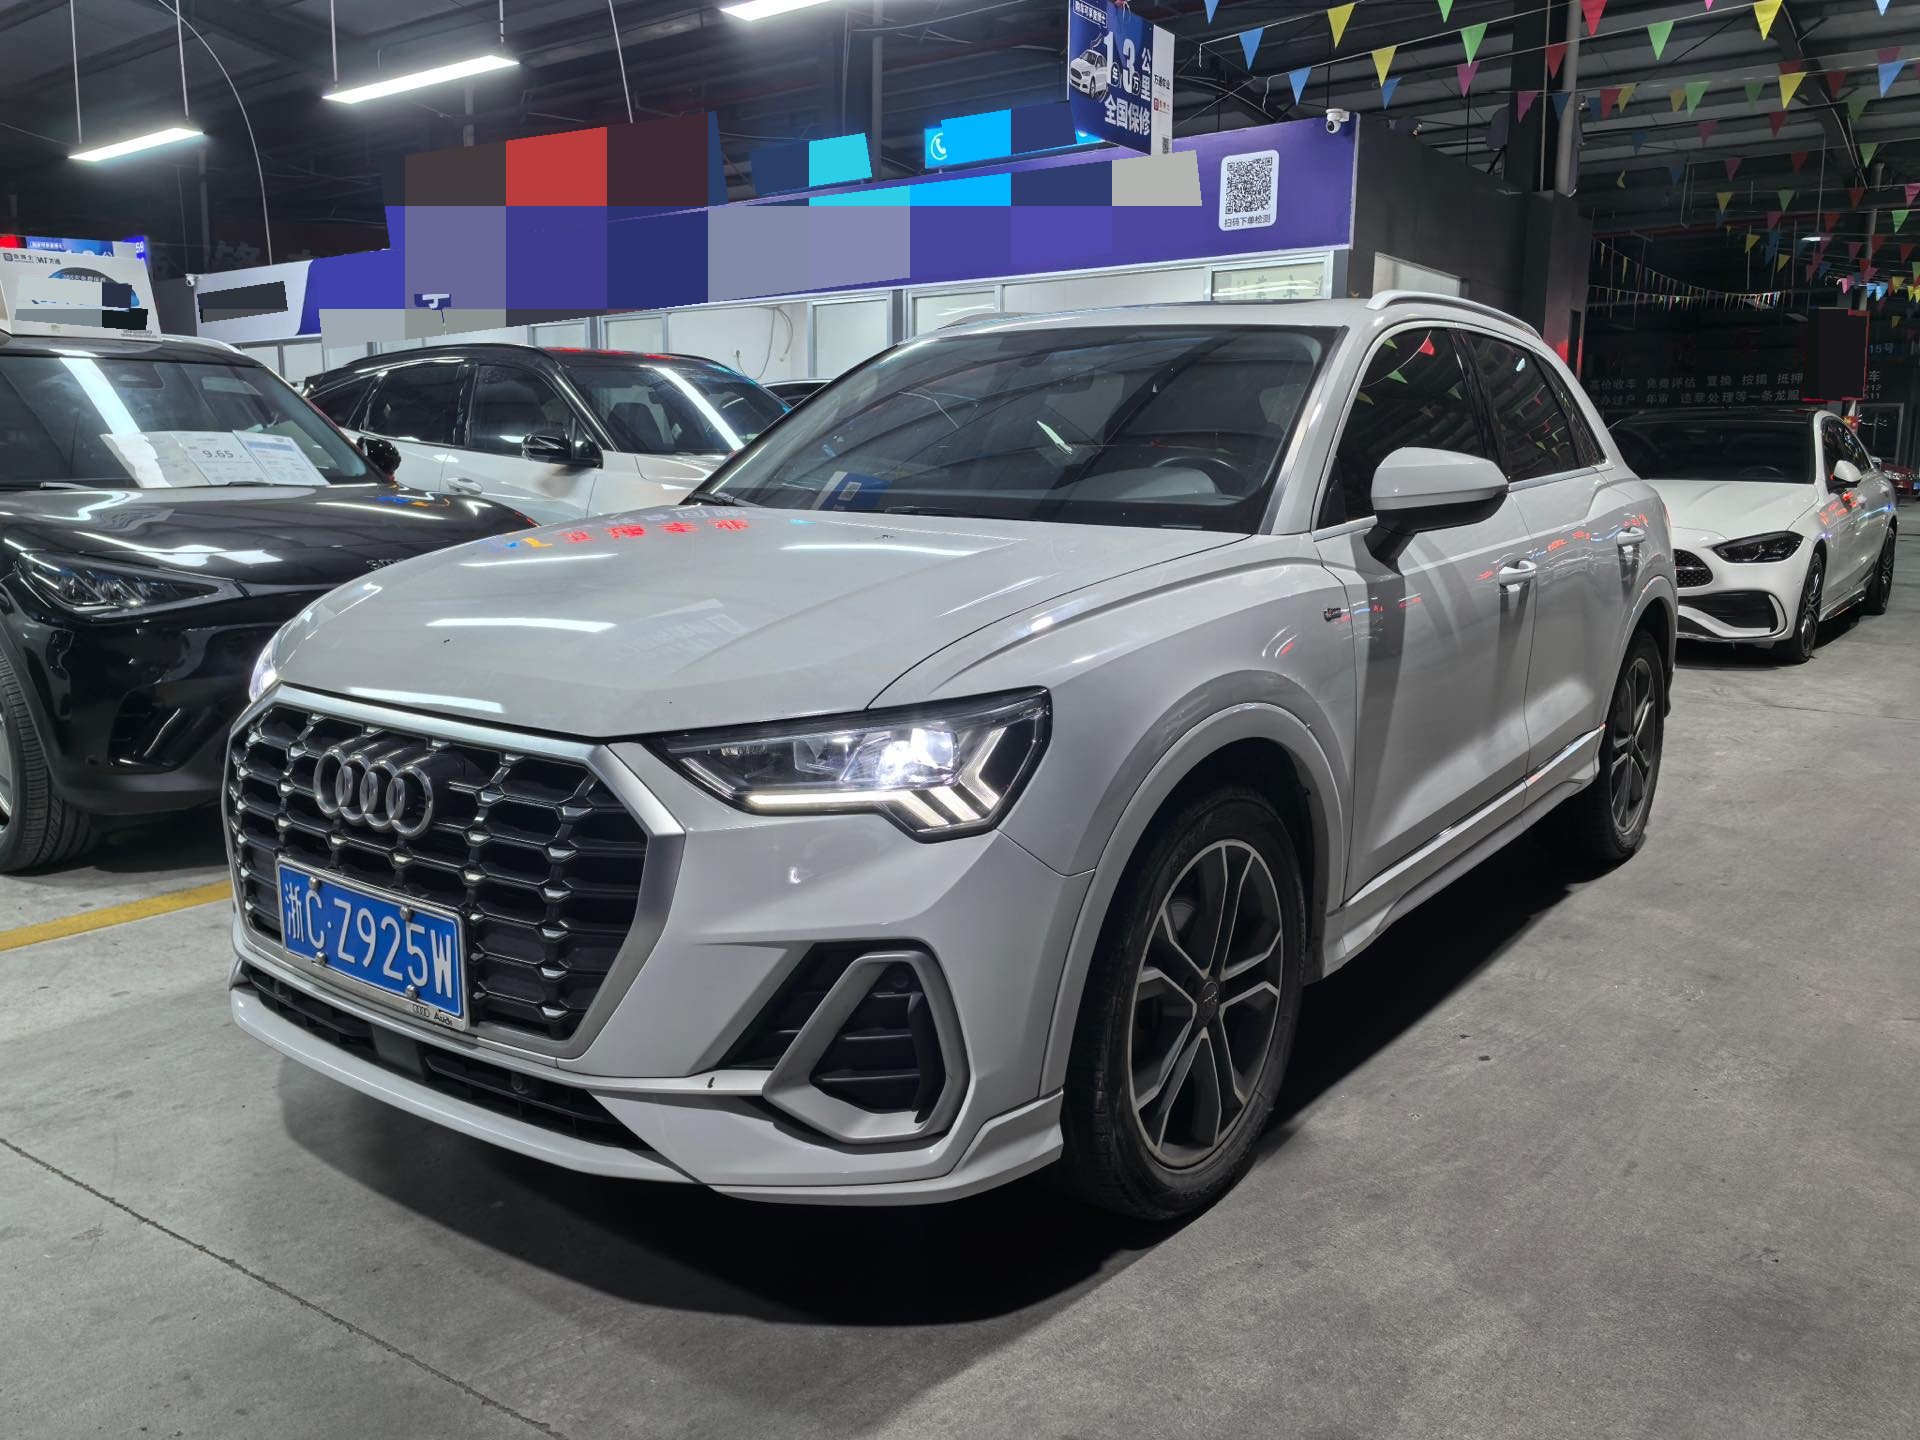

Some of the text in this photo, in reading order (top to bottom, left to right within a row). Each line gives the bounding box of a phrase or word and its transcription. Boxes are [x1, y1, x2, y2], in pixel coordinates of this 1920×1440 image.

[1104, 95, 1151, 136] 全国保修
[1224, 213, 1271, 228] 扫码下单检测
[202, 449, 234, 459] 9.65
[433, 1011, 453, 1027] Audi
